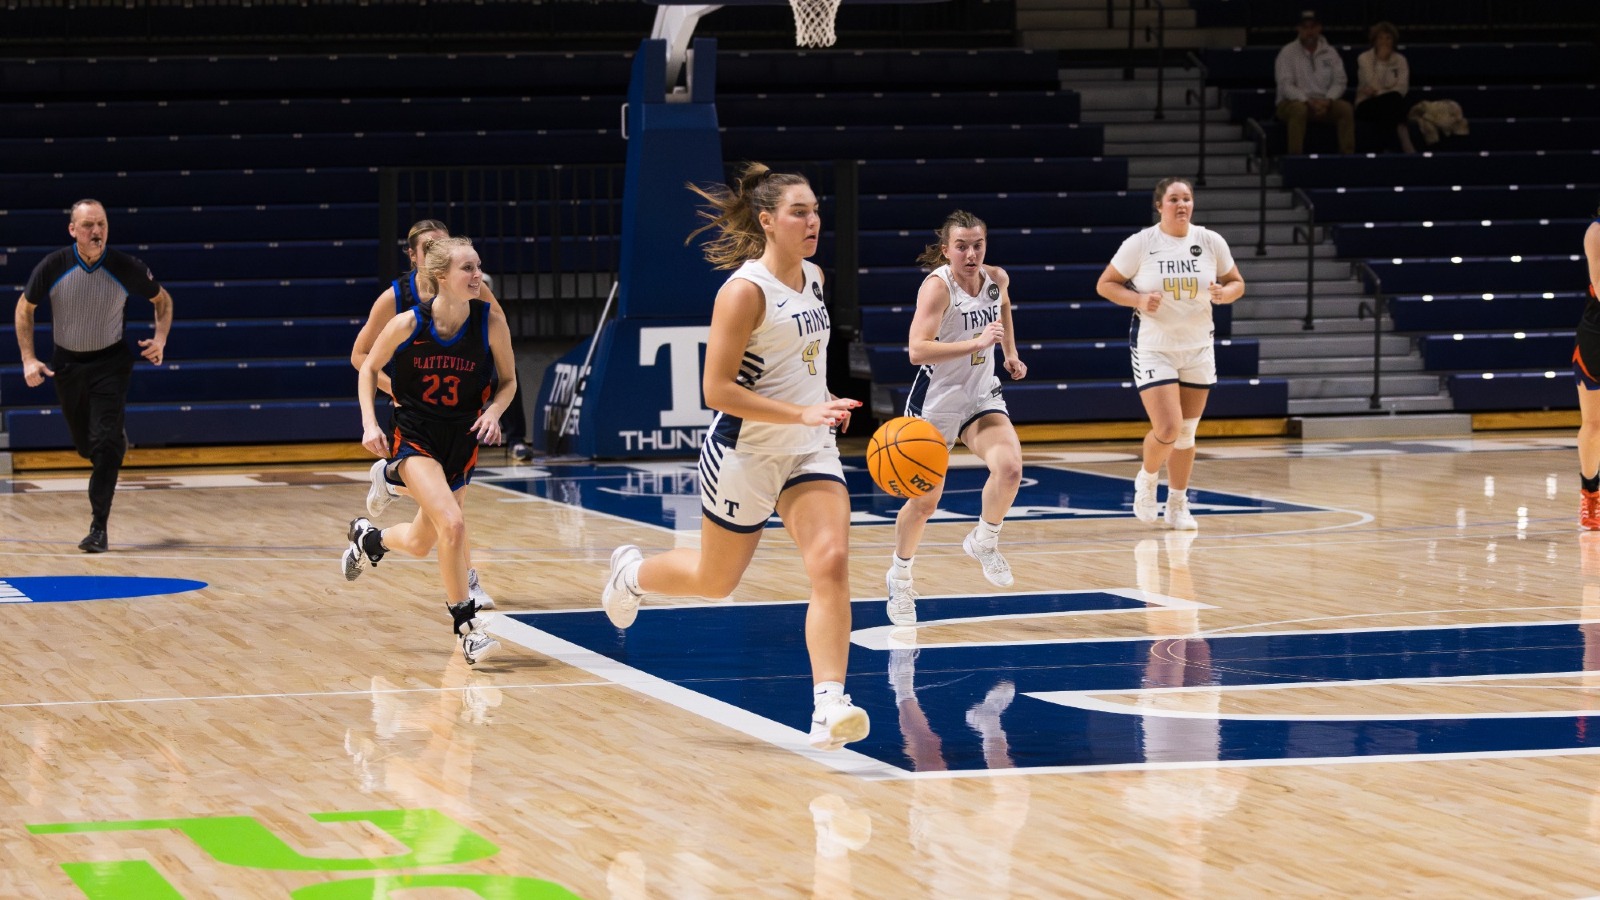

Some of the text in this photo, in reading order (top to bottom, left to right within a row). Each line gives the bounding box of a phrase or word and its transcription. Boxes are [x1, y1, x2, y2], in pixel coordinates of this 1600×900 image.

[1157, 259, 1201, 274] TRINE
[1163, 277, 1199, 301] 44
[791, 305, 830, 337] TRINE
[413, 355, 476, 372] PLATTEVILLE
[801, 339, 821, 376] 4
[639, 325, 714, 428] T
[1145, 369, 1156, 379] T
[422, 374, 461, 407] 23
[724, 498, 739, 518] T
